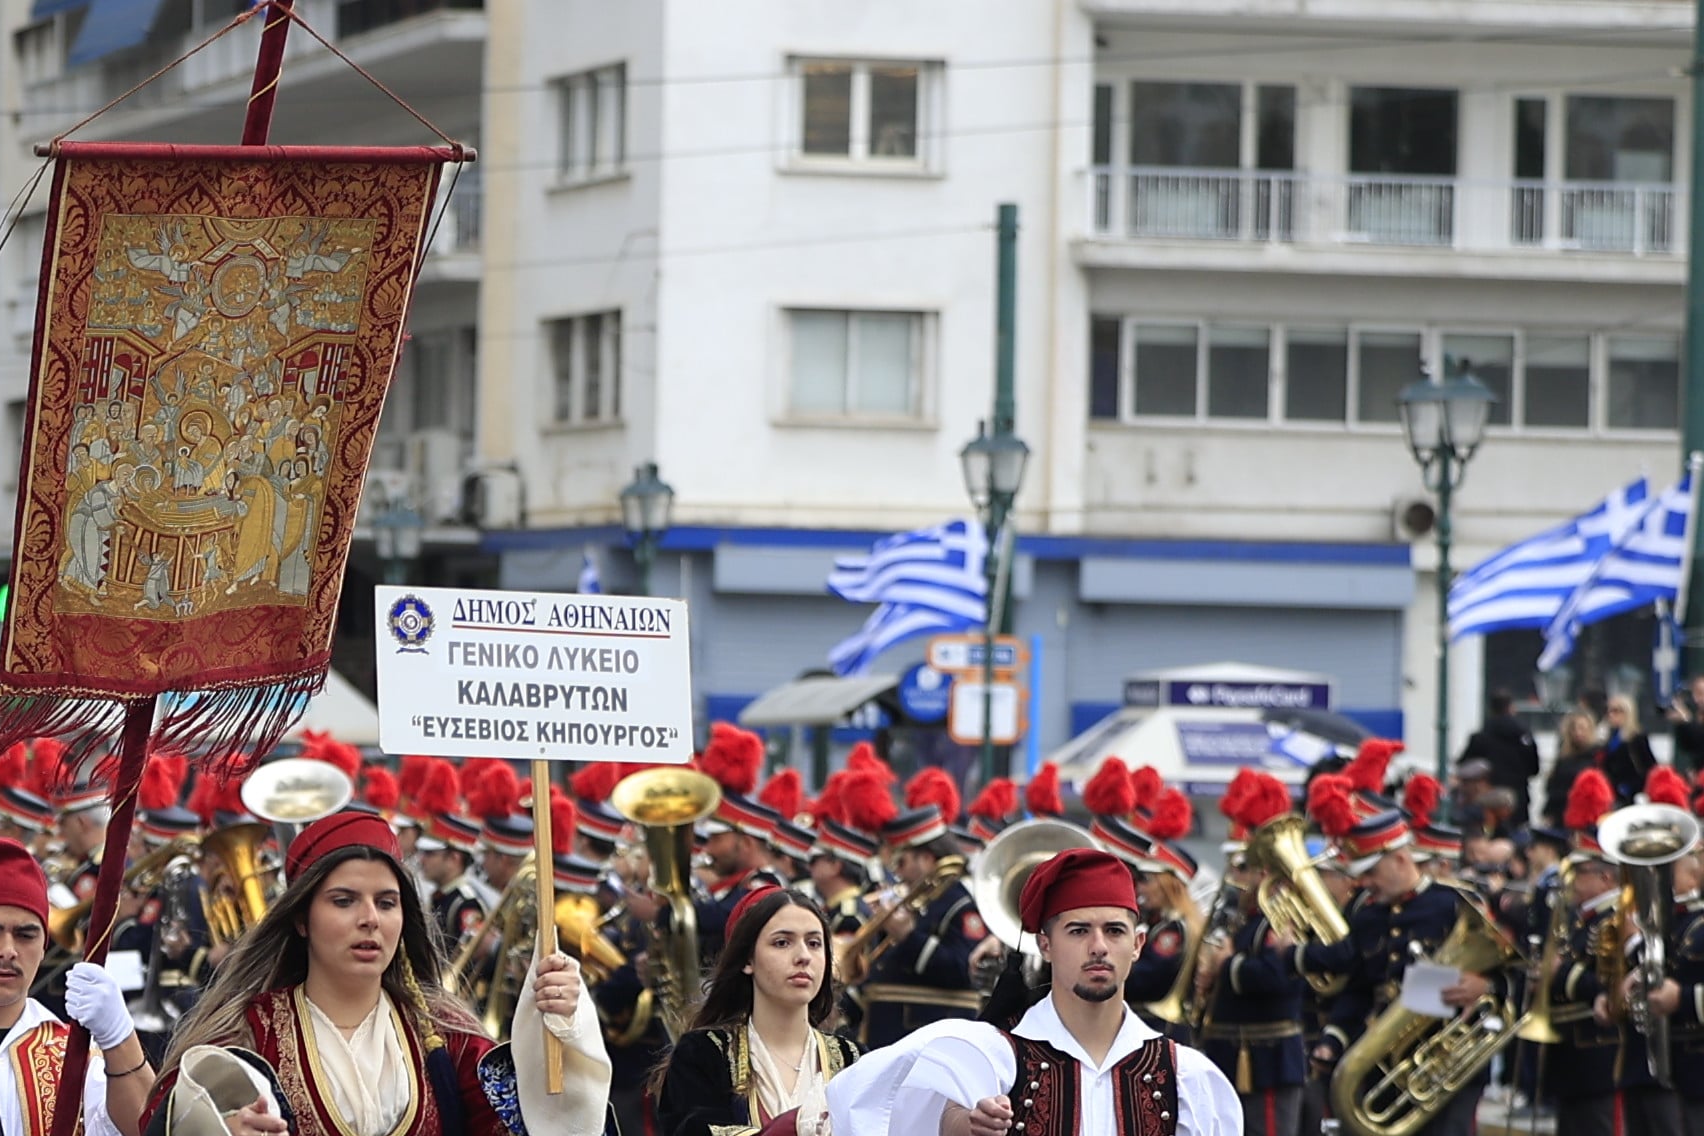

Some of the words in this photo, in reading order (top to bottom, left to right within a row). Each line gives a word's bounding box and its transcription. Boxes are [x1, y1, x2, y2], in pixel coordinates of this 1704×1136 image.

[452, 597, 536, 626] ΔΗΜΟΣ
[547, 602, 671, 633] ΑΘΗΝΑΙΩΝ
[448, 641, 539, 669] ΓΕΝΙΚΟ
[547, 646, 639, 674] ΛΥΚΕΙΟ
[457, 680, 628, 712] ΚΑΛΑΒΡΥΤΩΝ
[411, 715, 529, 742] “ΕΥΣΕΒΙΟΣ
